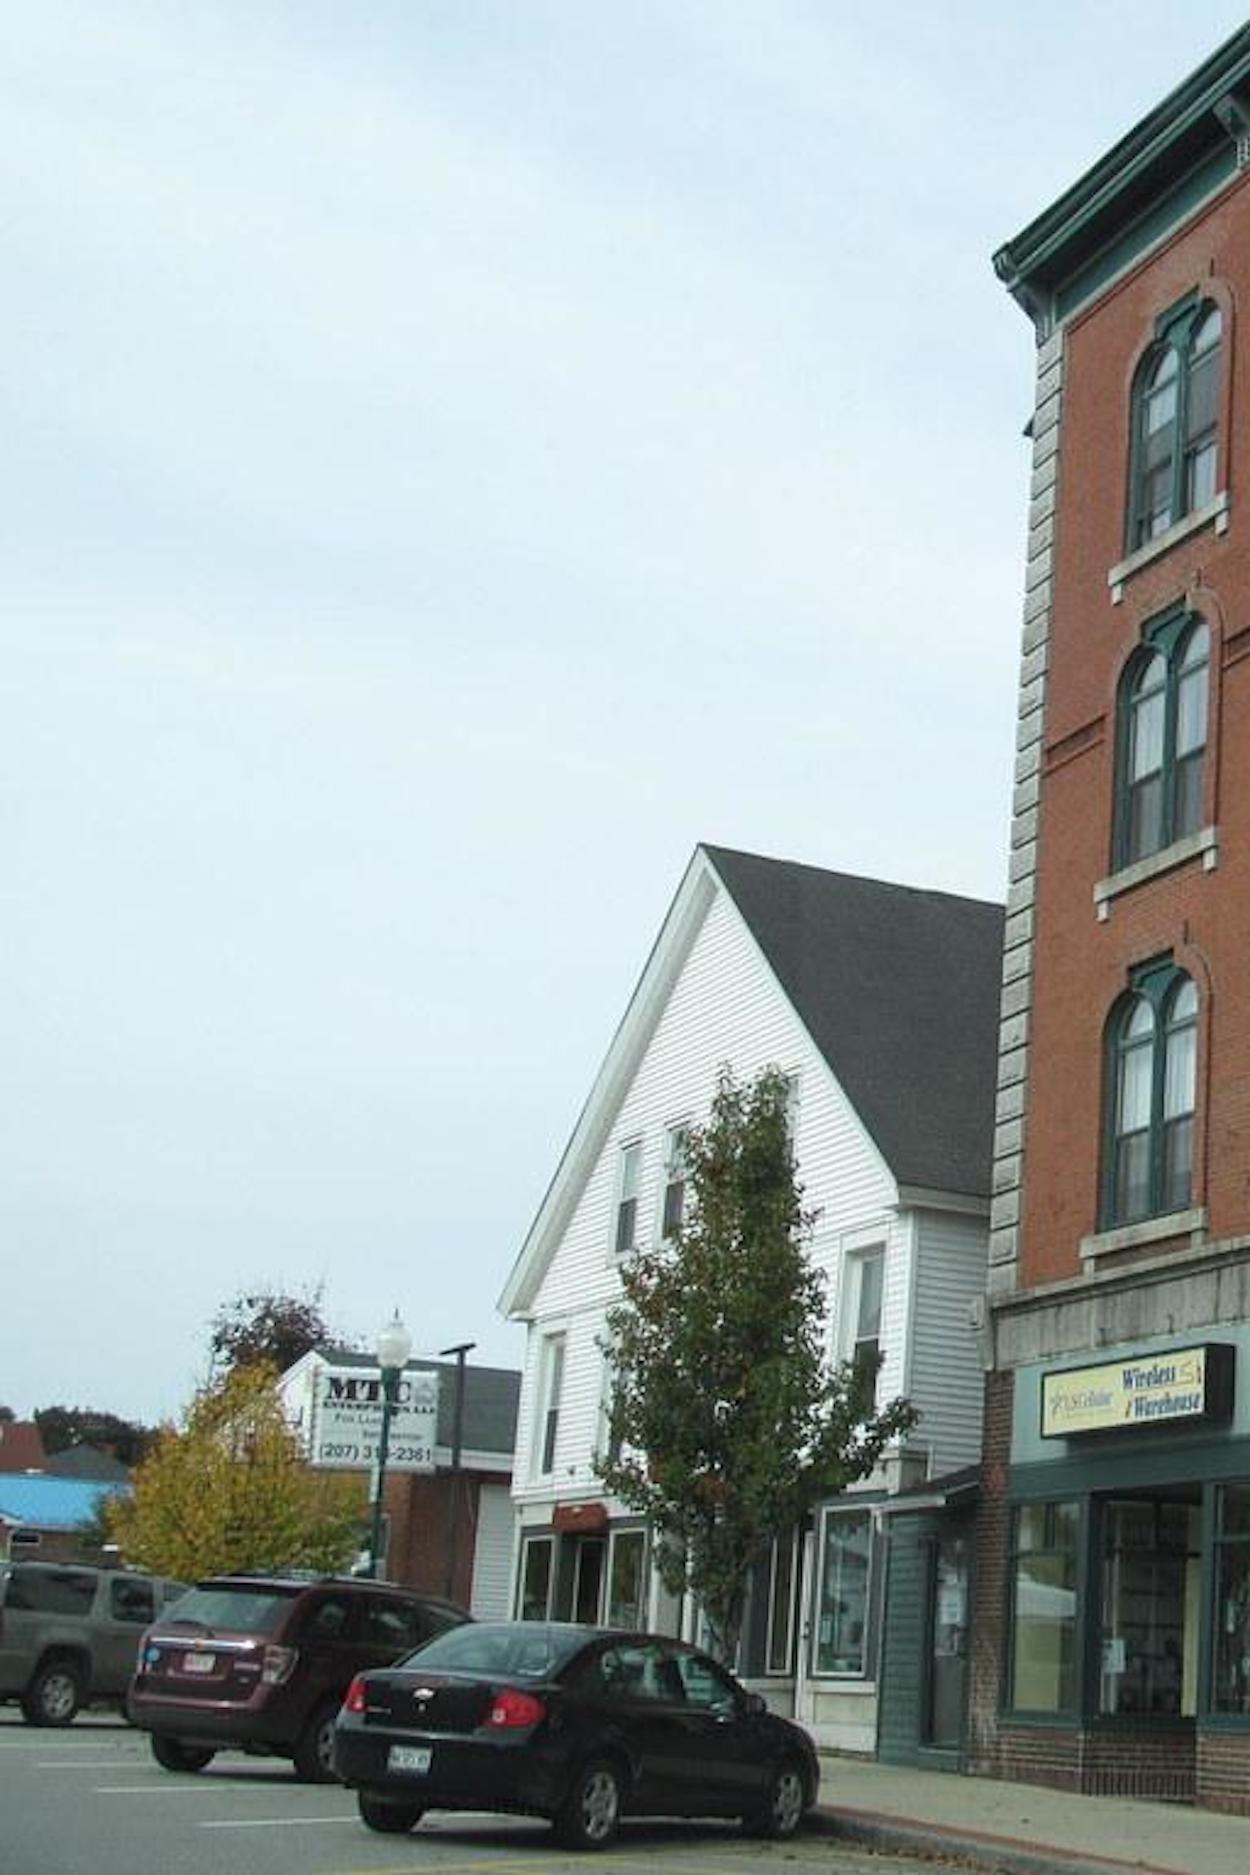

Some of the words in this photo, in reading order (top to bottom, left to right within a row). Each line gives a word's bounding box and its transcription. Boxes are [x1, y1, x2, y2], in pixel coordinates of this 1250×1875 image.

[1123, 1364, 1176, 1390] Wireless
[1135, 1392, 1201, 1418] Warehouse
[320, 1443, 359, 1460] (207)
[363, 1445, 431, 1462] 31-2361
